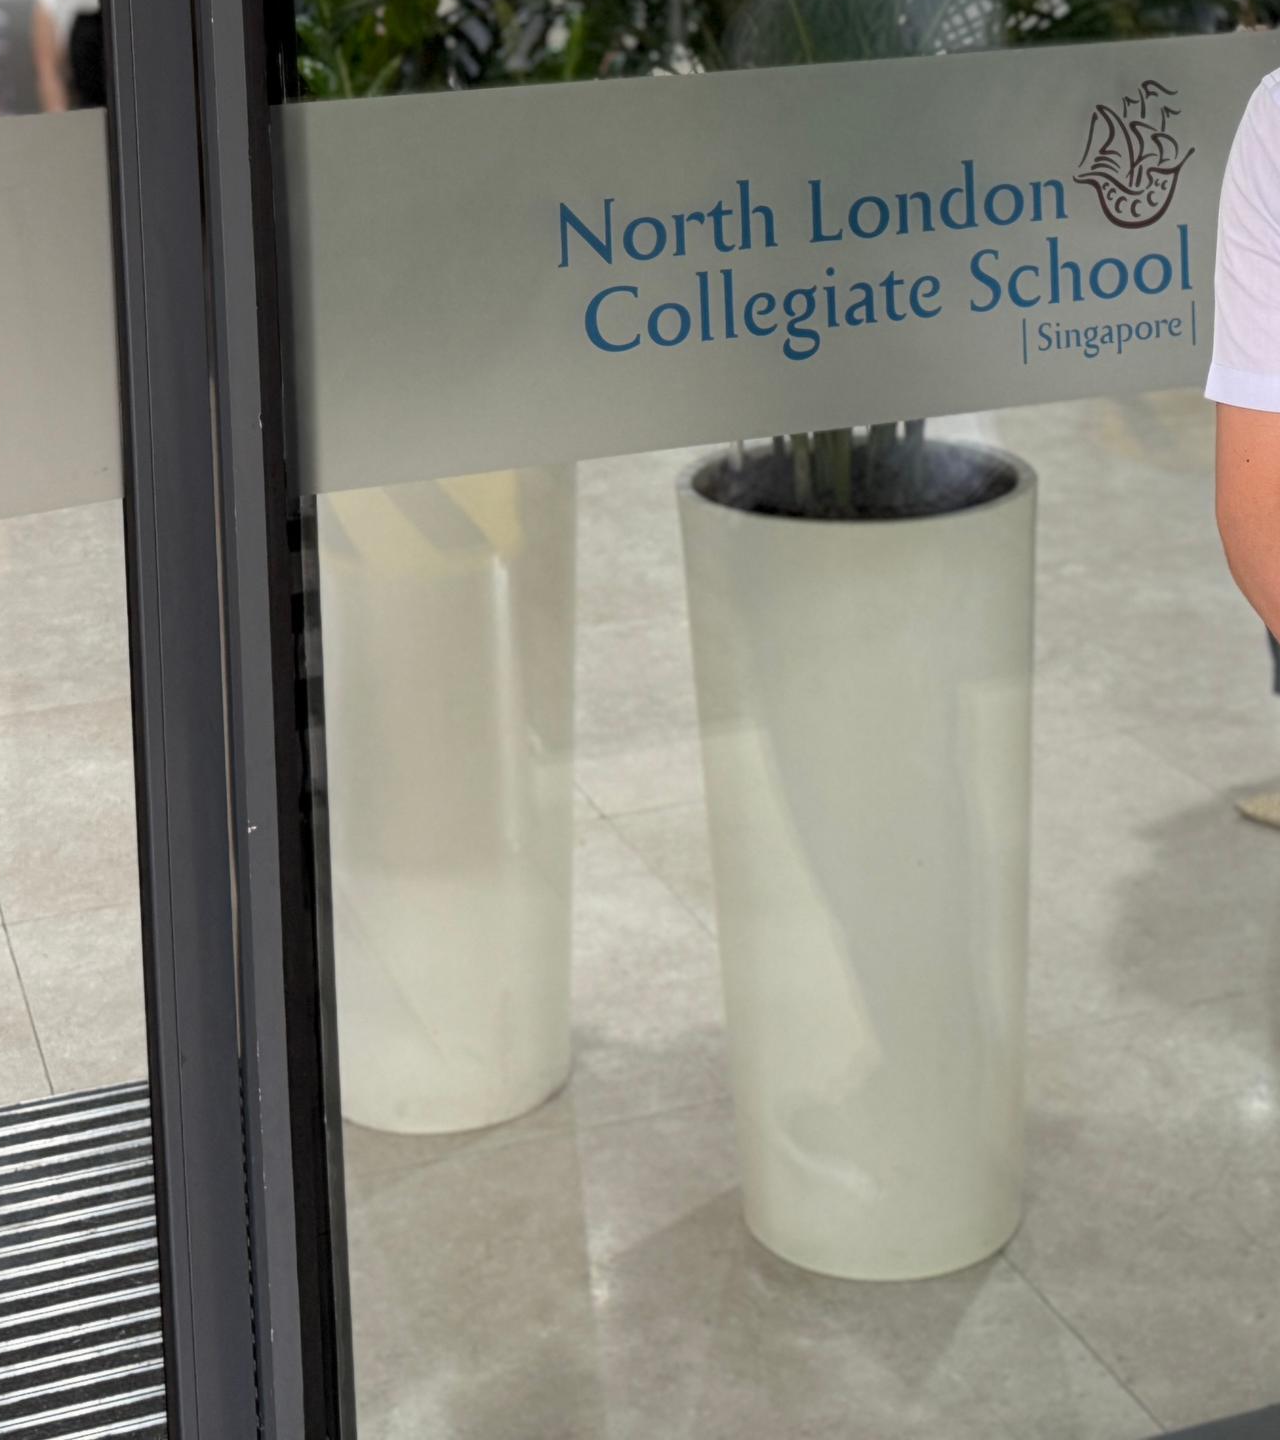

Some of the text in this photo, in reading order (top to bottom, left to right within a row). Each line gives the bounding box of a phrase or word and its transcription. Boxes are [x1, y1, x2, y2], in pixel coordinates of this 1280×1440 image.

[557, 159, 1069, 269] North London
[583, 223, 1194, 362] Collegiate School
[1036, 317, 1183, 359] Singapore
